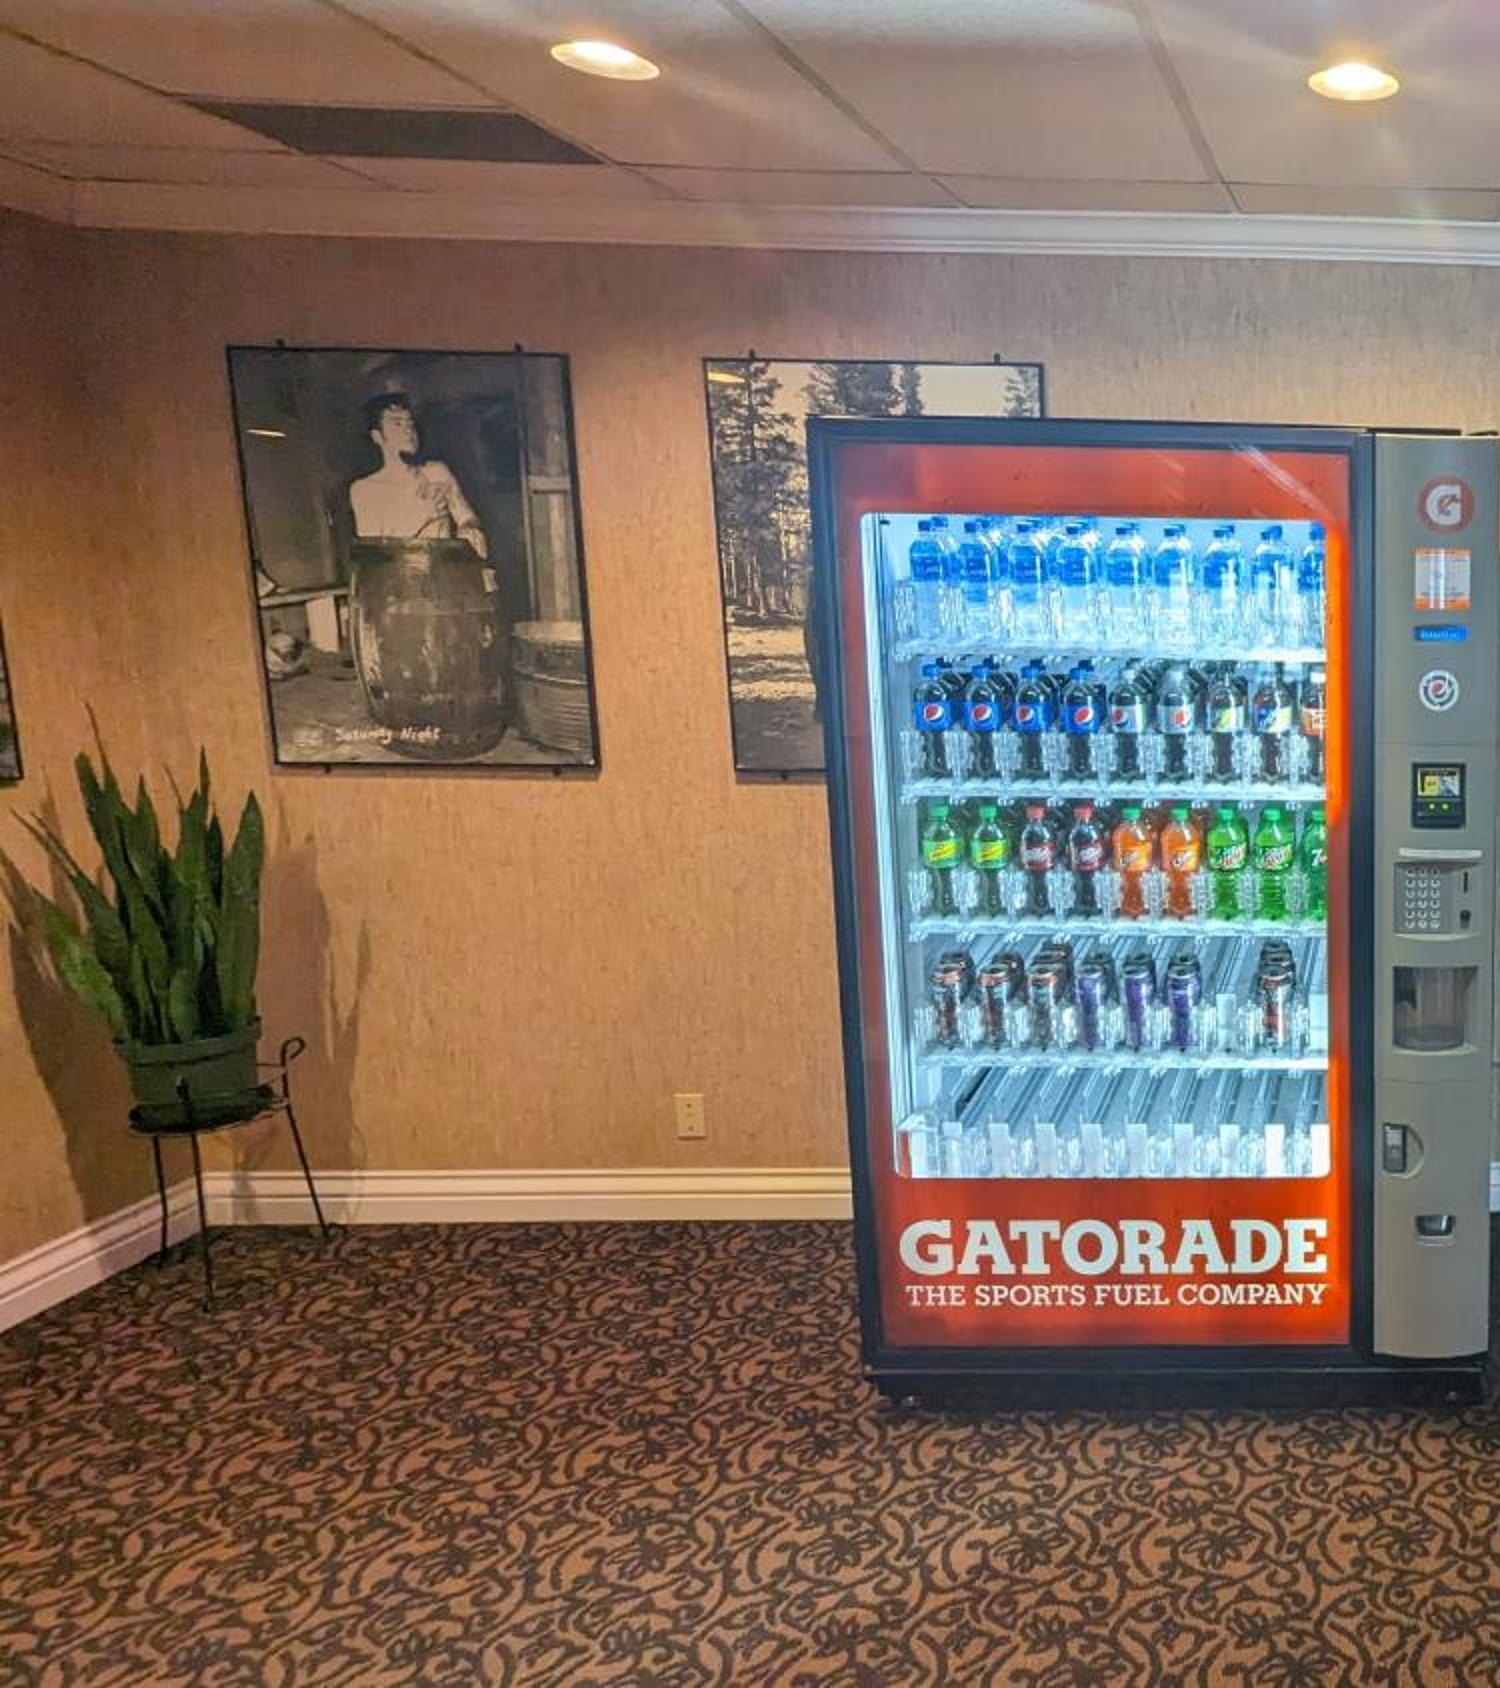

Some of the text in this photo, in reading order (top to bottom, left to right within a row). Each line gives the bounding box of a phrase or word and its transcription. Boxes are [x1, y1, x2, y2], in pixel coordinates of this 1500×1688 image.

[900, 1219, 1328, 1275] GATORADE
[906, 1283, 1329, 1307] THE SPORTS FUEL COMPANY
